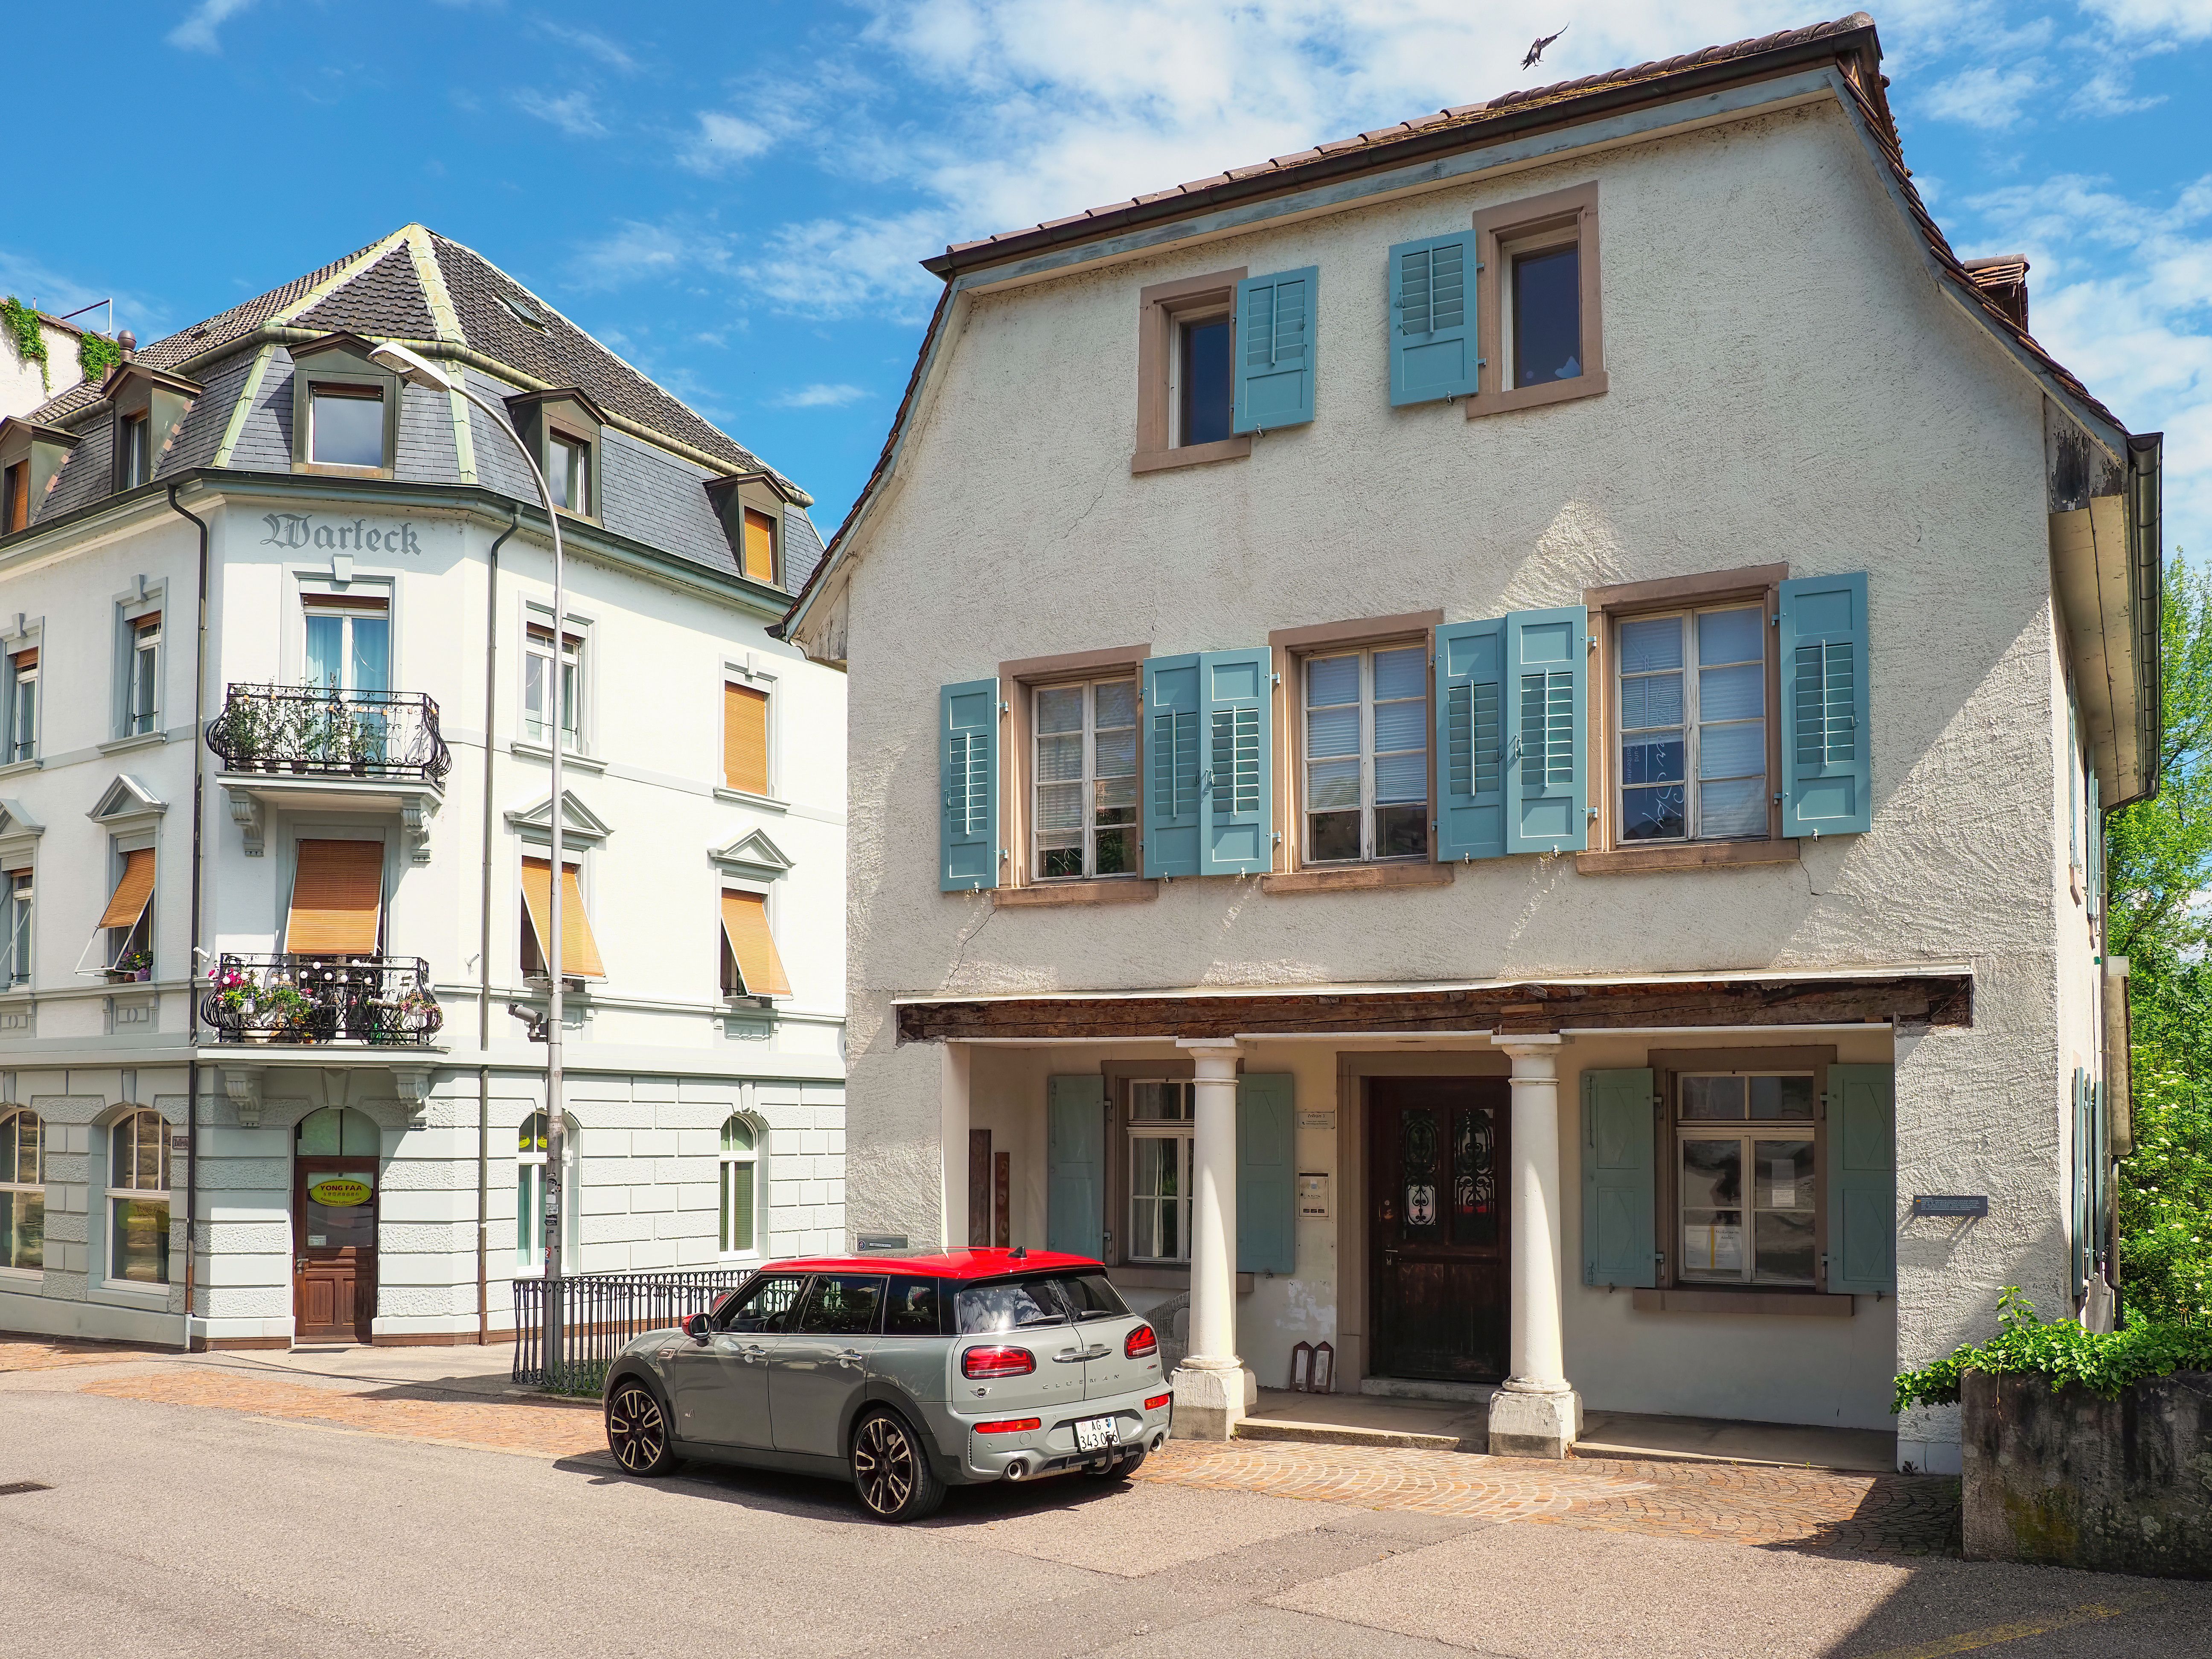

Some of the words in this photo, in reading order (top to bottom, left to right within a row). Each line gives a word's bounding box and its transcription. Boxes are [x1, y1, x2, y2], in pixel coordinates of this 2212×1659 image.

[1642, 772, 1685, 829] Sky
[1092, 1420, 1101, 1431] AG
[1080, 1433, 1098, 1449] 343
